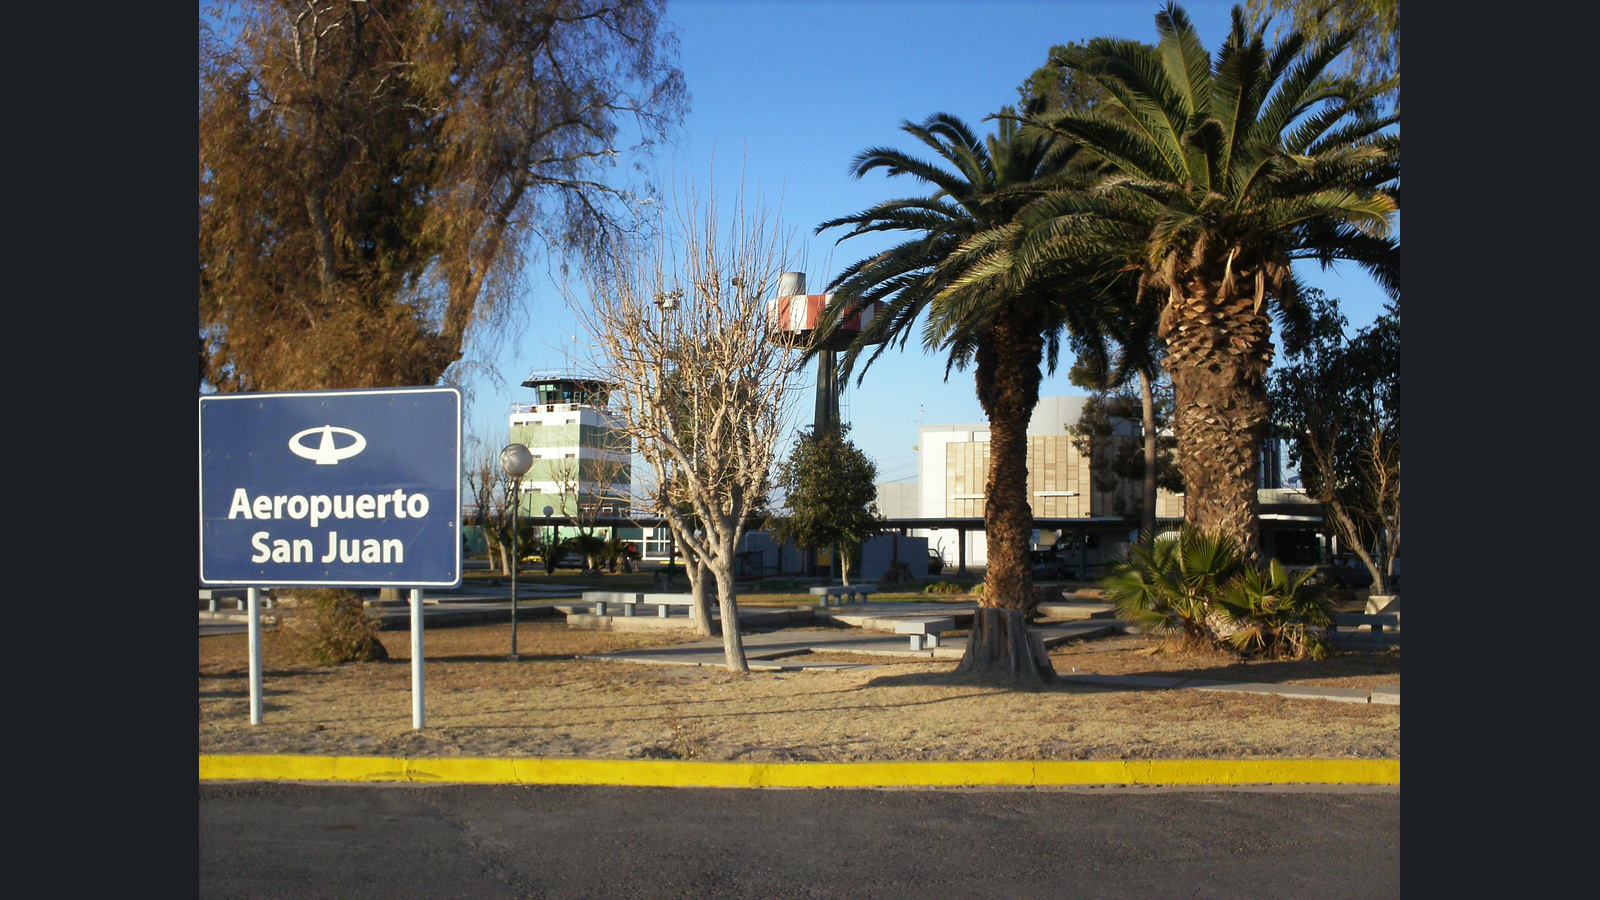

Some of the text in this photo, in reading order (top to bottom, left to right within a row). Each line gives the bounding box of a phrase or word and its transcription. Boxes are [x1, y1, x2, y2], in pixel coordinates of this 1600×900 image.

[228, 488, 430, 528] Aeropuerto
[251, 531, 404, 564] San Juan
